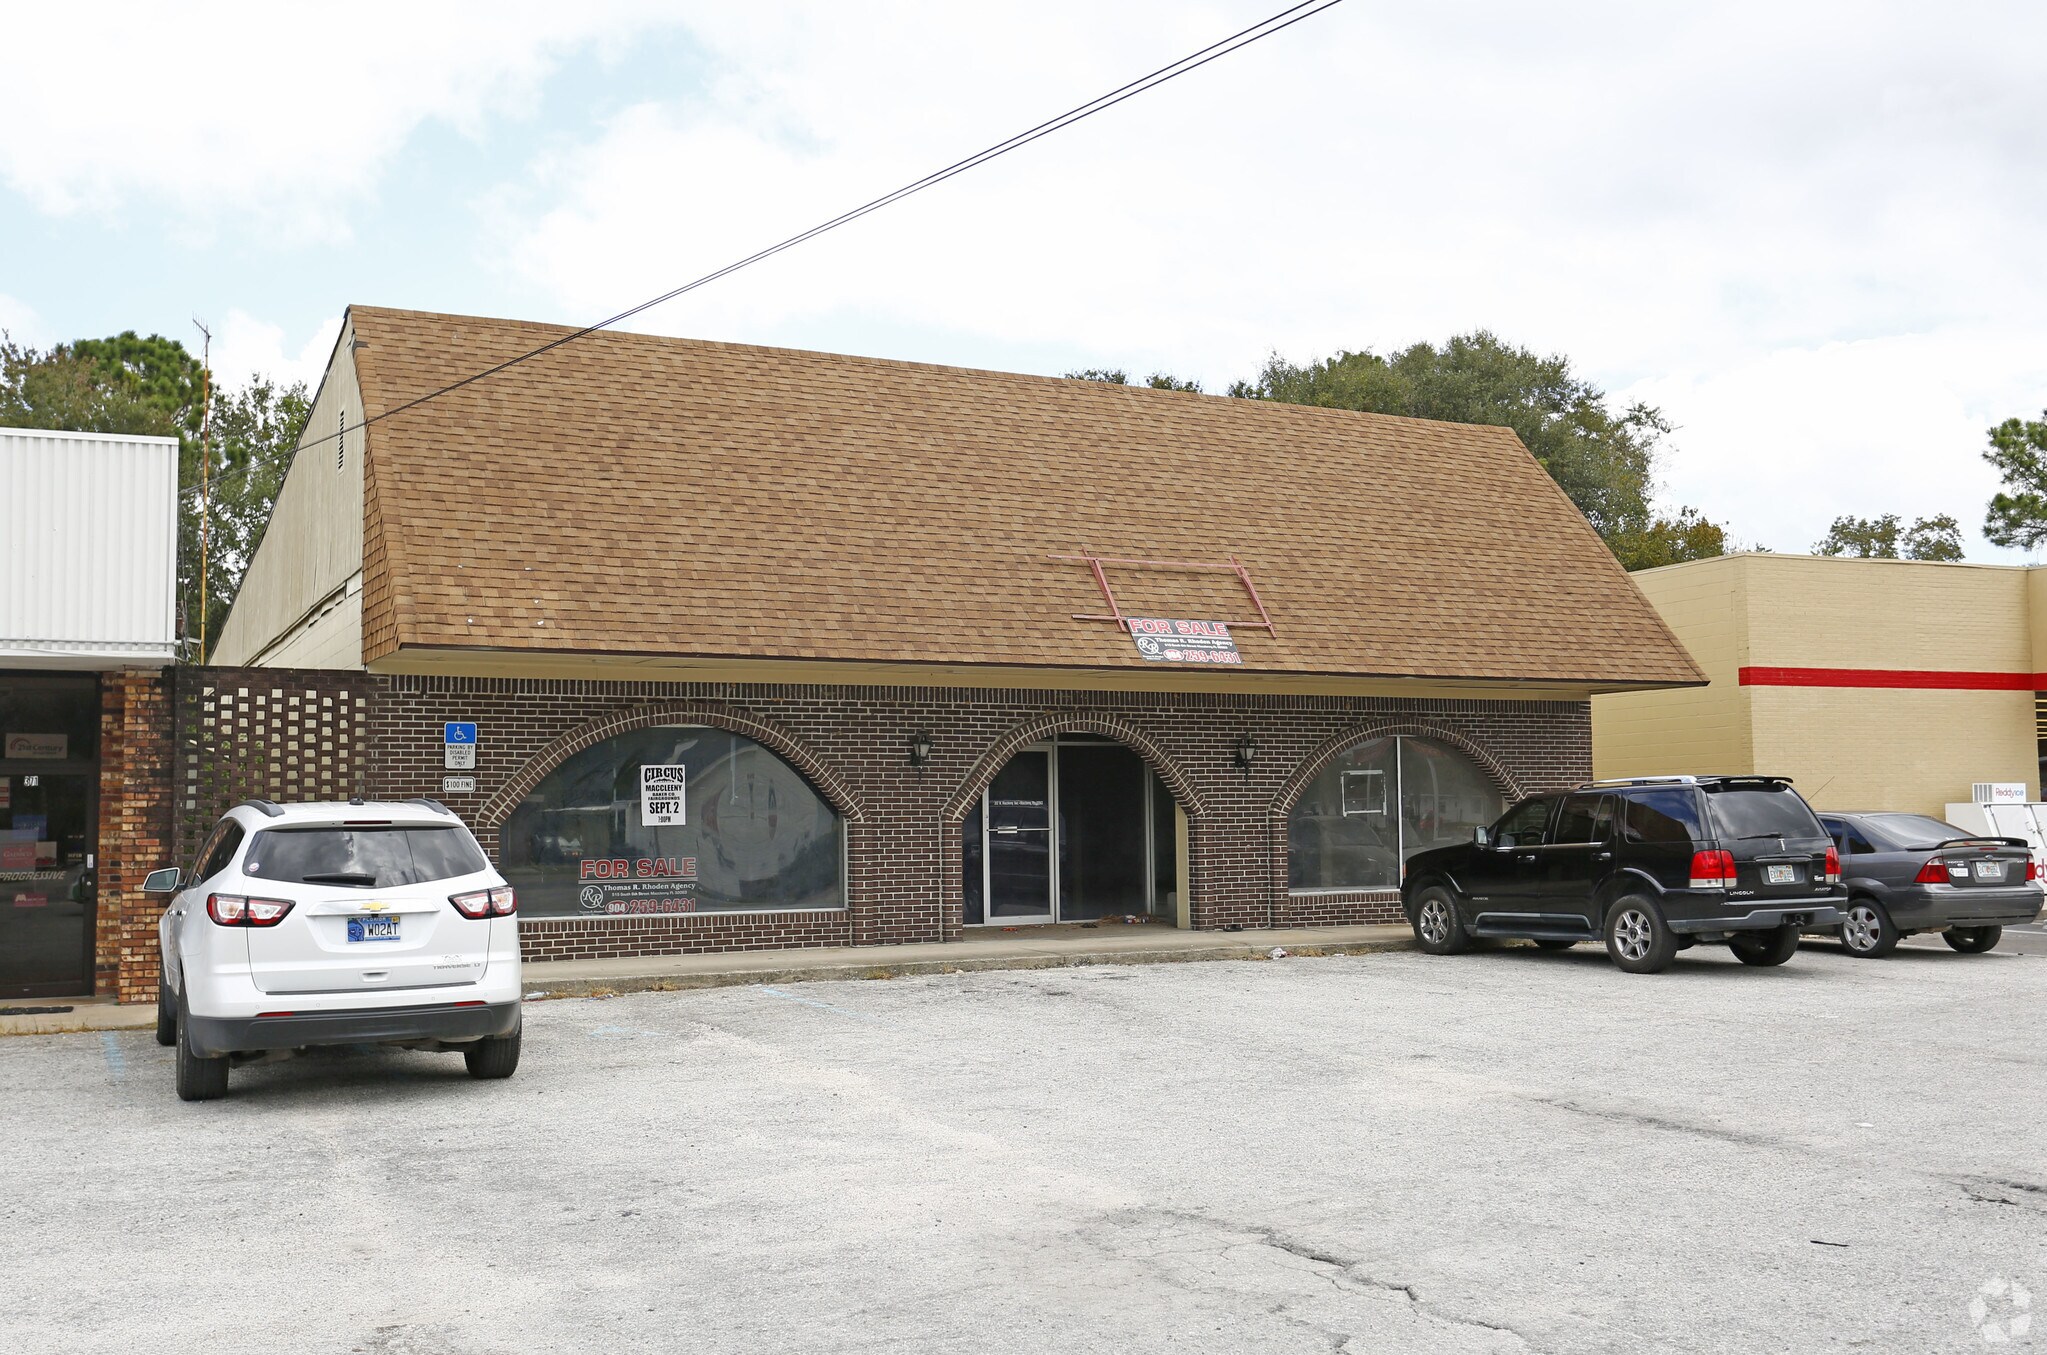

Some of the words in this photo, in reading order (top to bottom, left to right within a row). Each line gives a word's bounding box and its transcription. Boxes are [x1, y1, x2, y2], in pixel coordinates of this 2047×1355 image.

[1128, 619, 1173, 633] FOR
[1175, 621, 1229, 636] SALE
[1211, 639, 1233, 647] Agency
[1182, 649, 1242, 664] 259-6431
[644, 767, 684, 783] CIRCUS
[446, 781, 460, 789] $100
[460, 780, 473, 789] FINE
[649, 801, 672, 814] SEPT.
[673, 801, 680, 814] 2
[580, 858, 629, 879] FOR
[636, 856, 697, 877] SALE
[0, 871, 67, 881] PROGRESSIVE
[603, 884, 631, 892] Thomas
[670, 882, 696, 891] Agency
[608, 903, 626, 913] 904
[629, 898, 696, 914] 259-6431
